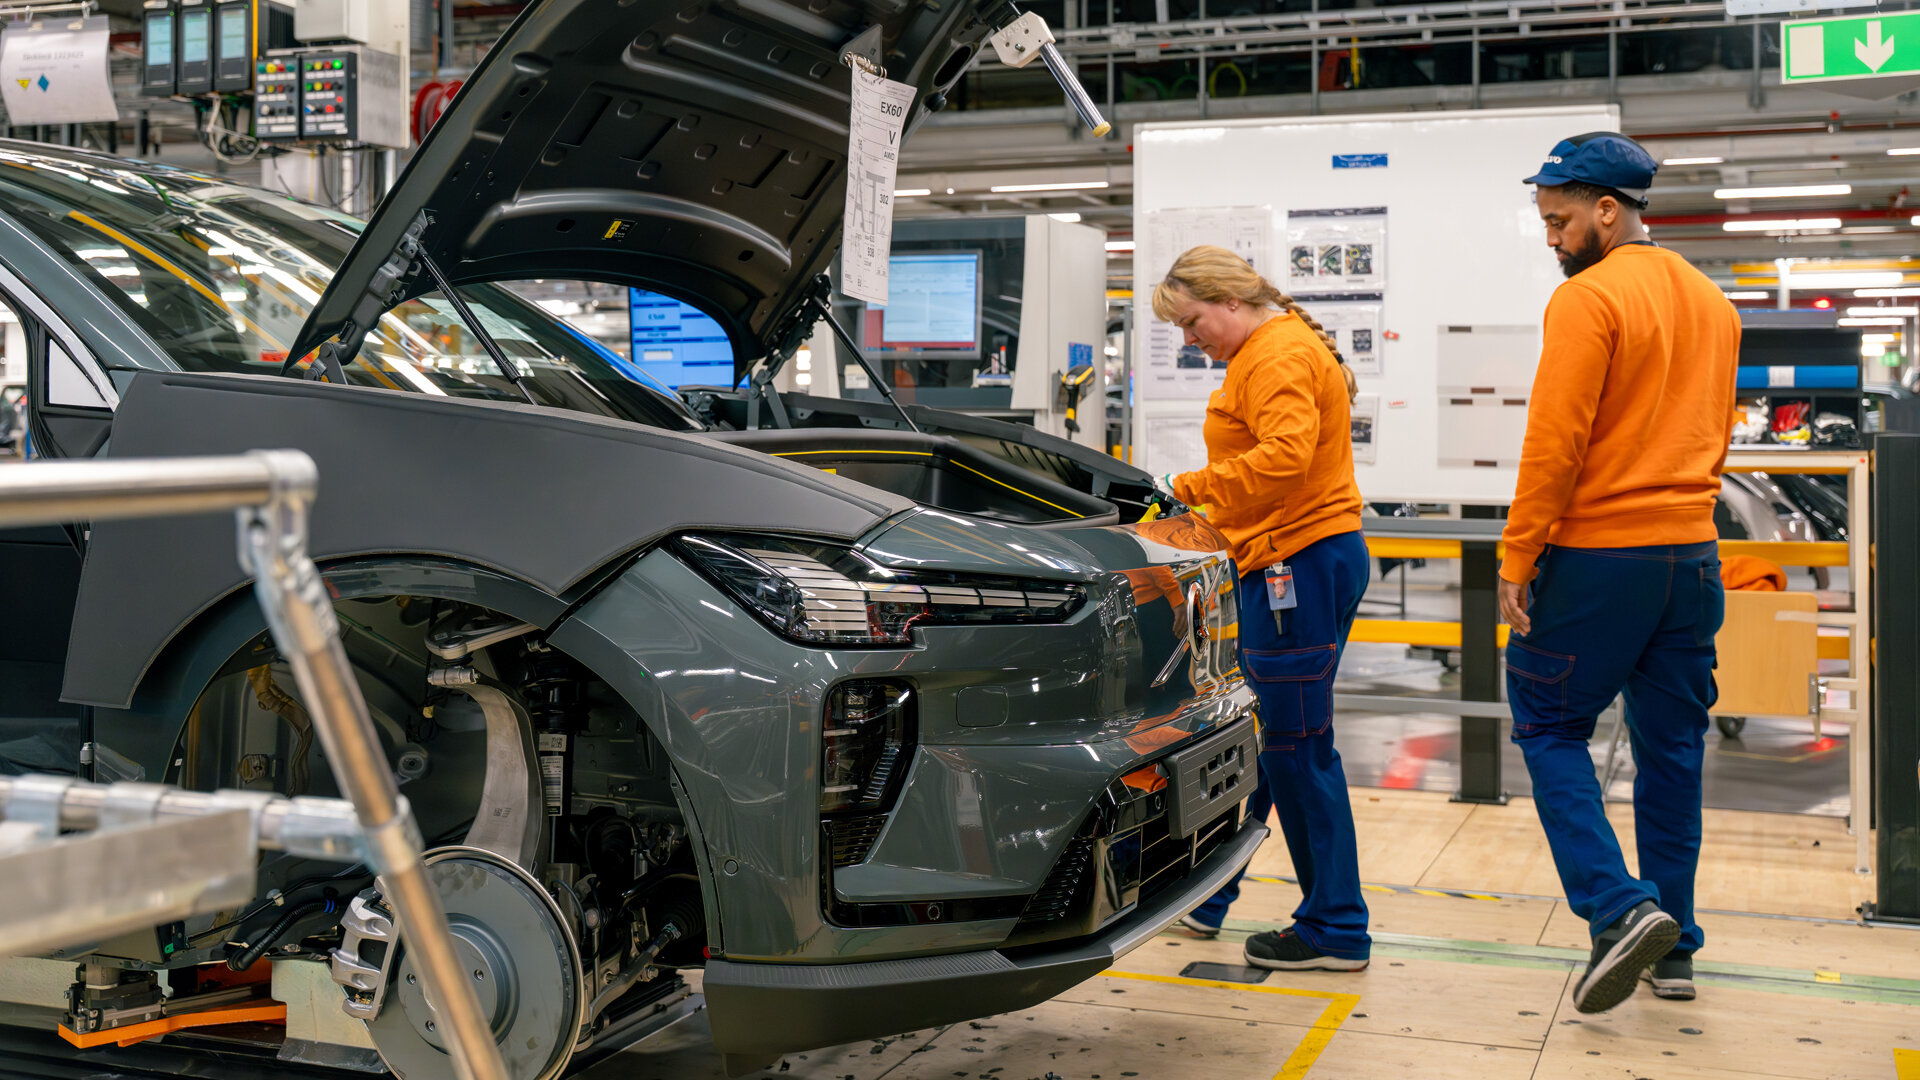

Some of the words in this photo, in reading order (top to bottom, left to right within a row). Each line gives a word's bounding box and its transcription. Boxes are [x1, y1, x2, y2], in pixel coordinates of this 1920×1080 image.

[880, 102, 903, 118] EX60
[888, 130, 897, 145] V
[879, 193, 889, 205] 302
